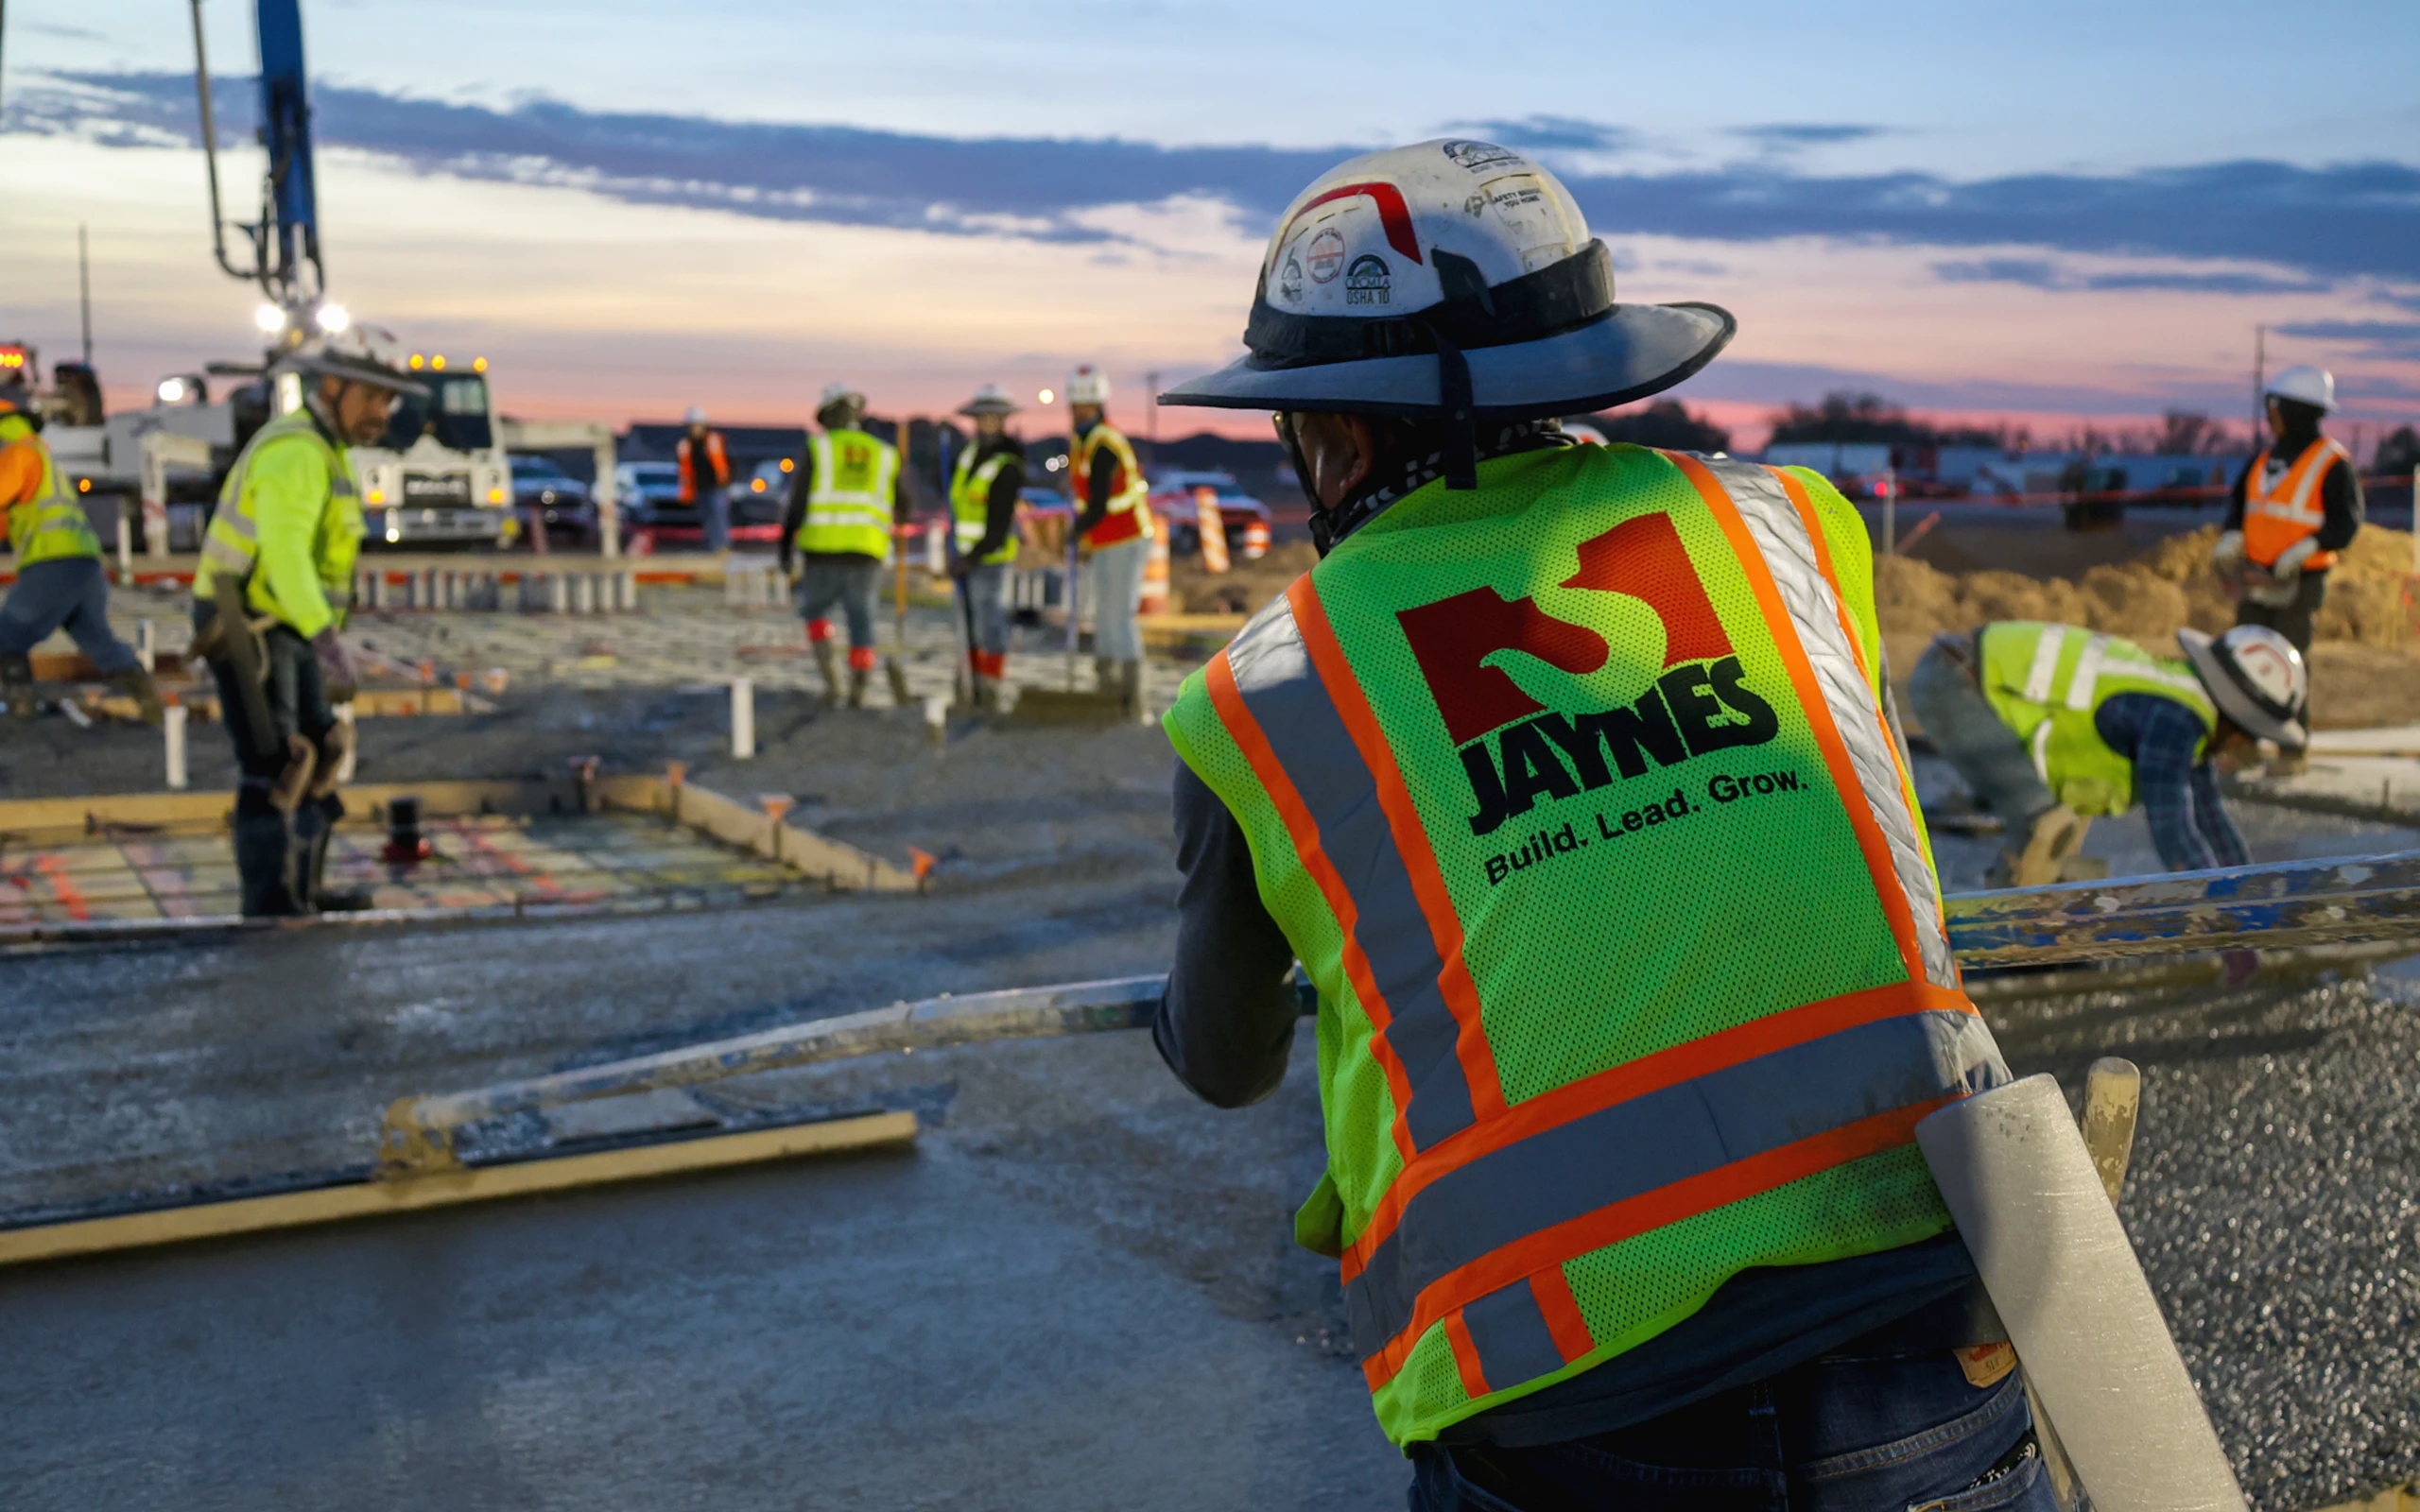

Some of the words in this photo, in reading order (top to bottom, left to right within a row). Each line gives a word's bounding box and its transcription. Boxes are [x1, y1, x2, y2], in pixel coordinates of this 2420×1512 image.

[1346, 290, 1374, 304] OSHA
[1377, 290, 1390, 304] 10
[1459, 656, 1779, 836] JAYNES
[1484, 823, 1588, 885] Build.
[1596, 788, 1701, 842] Lead.
[1709, 769, 1808, 804] Grow.
